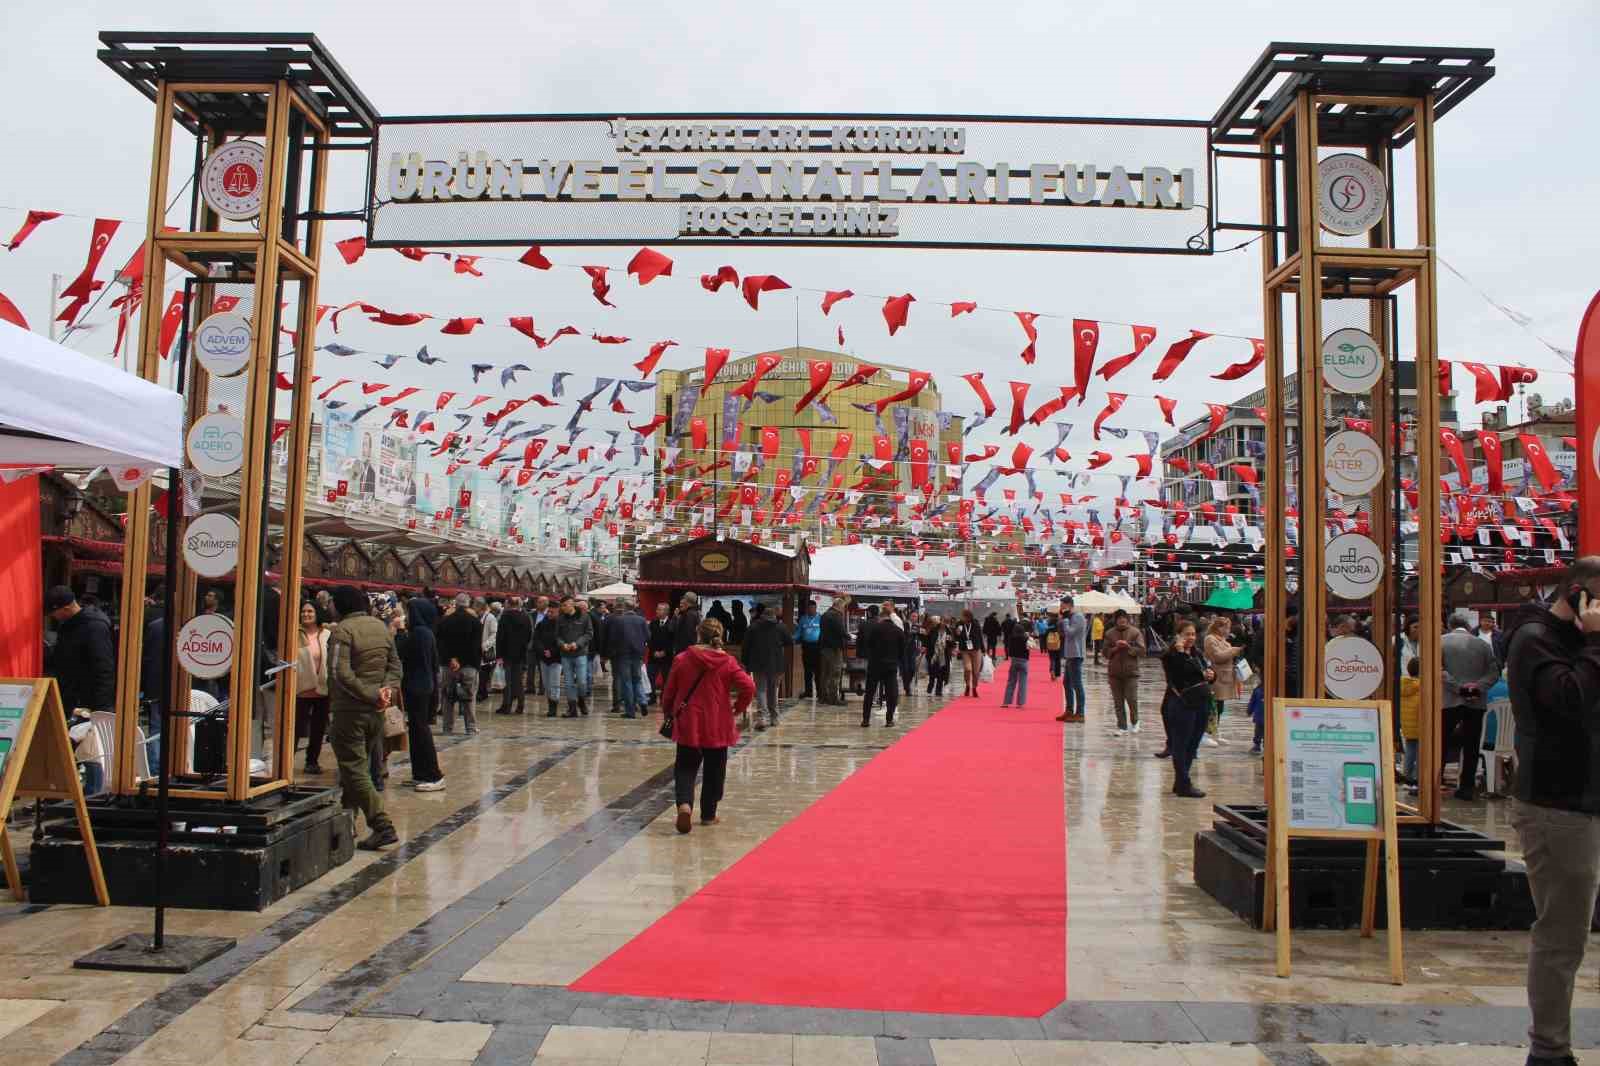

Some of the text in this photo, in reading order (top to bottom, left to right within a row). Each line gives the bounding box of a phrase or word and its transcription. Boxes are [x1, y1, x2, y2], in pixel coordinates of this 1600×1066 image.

[616, 117, 966, 155] İŞYURTLARI KURUMU
[389, 152, 1195, 208] ÜRÜN VE EL SANATLARI FUARI
[679, 201, 900, 238] HOŞGELDİNİZ
[207, 335, 246, 345] ADVEM
[1324, 354, 1365, 365] ELBAN
[1326, 564, 1371, 574] ADNORA
[1334, 665, 1379, 673] ADEMODA
